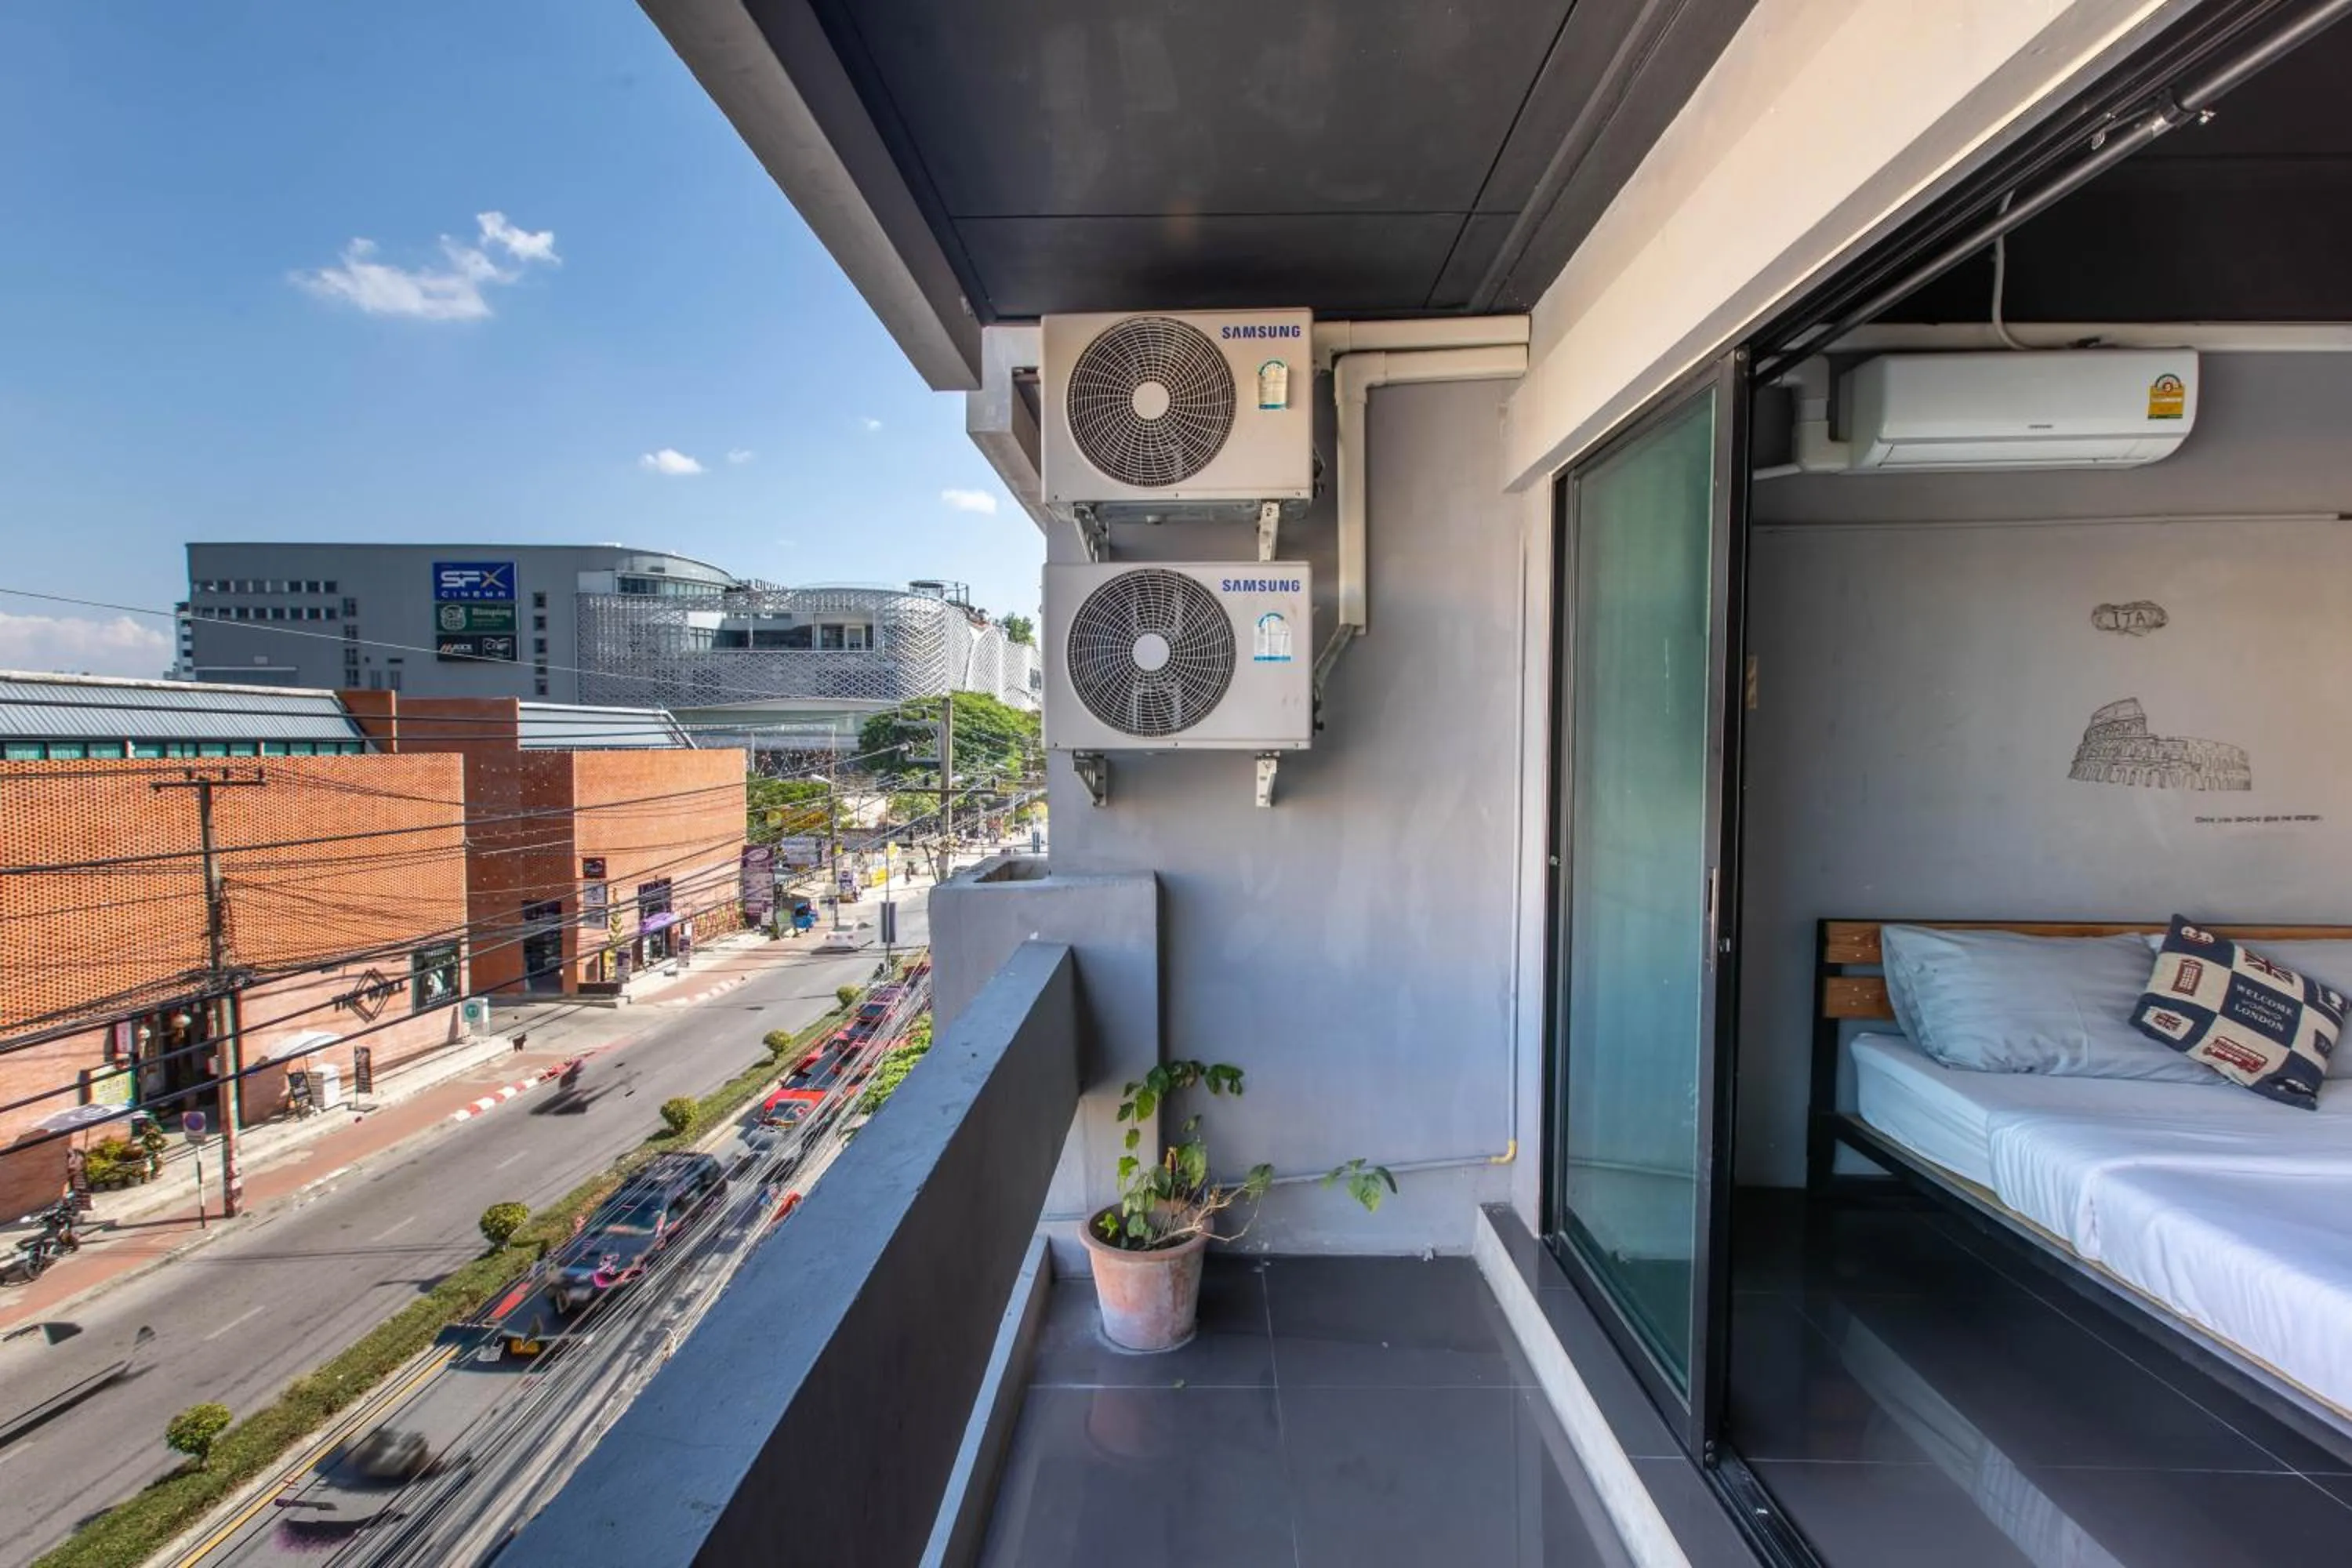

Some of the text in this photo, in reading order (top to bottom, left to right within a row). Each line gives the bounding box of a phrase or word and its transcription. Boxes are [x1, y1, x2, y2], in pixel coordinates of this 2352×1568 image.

[1221, 325, 1301, 339] SAMSUNG
[441, 564, 510, 588] SFX
[1221, 579, 1301, 592] SAMSUNG
[2236, 983, 2293, 1017] WELCOME
[2234, 1003, 2285, 1032] LONDON
